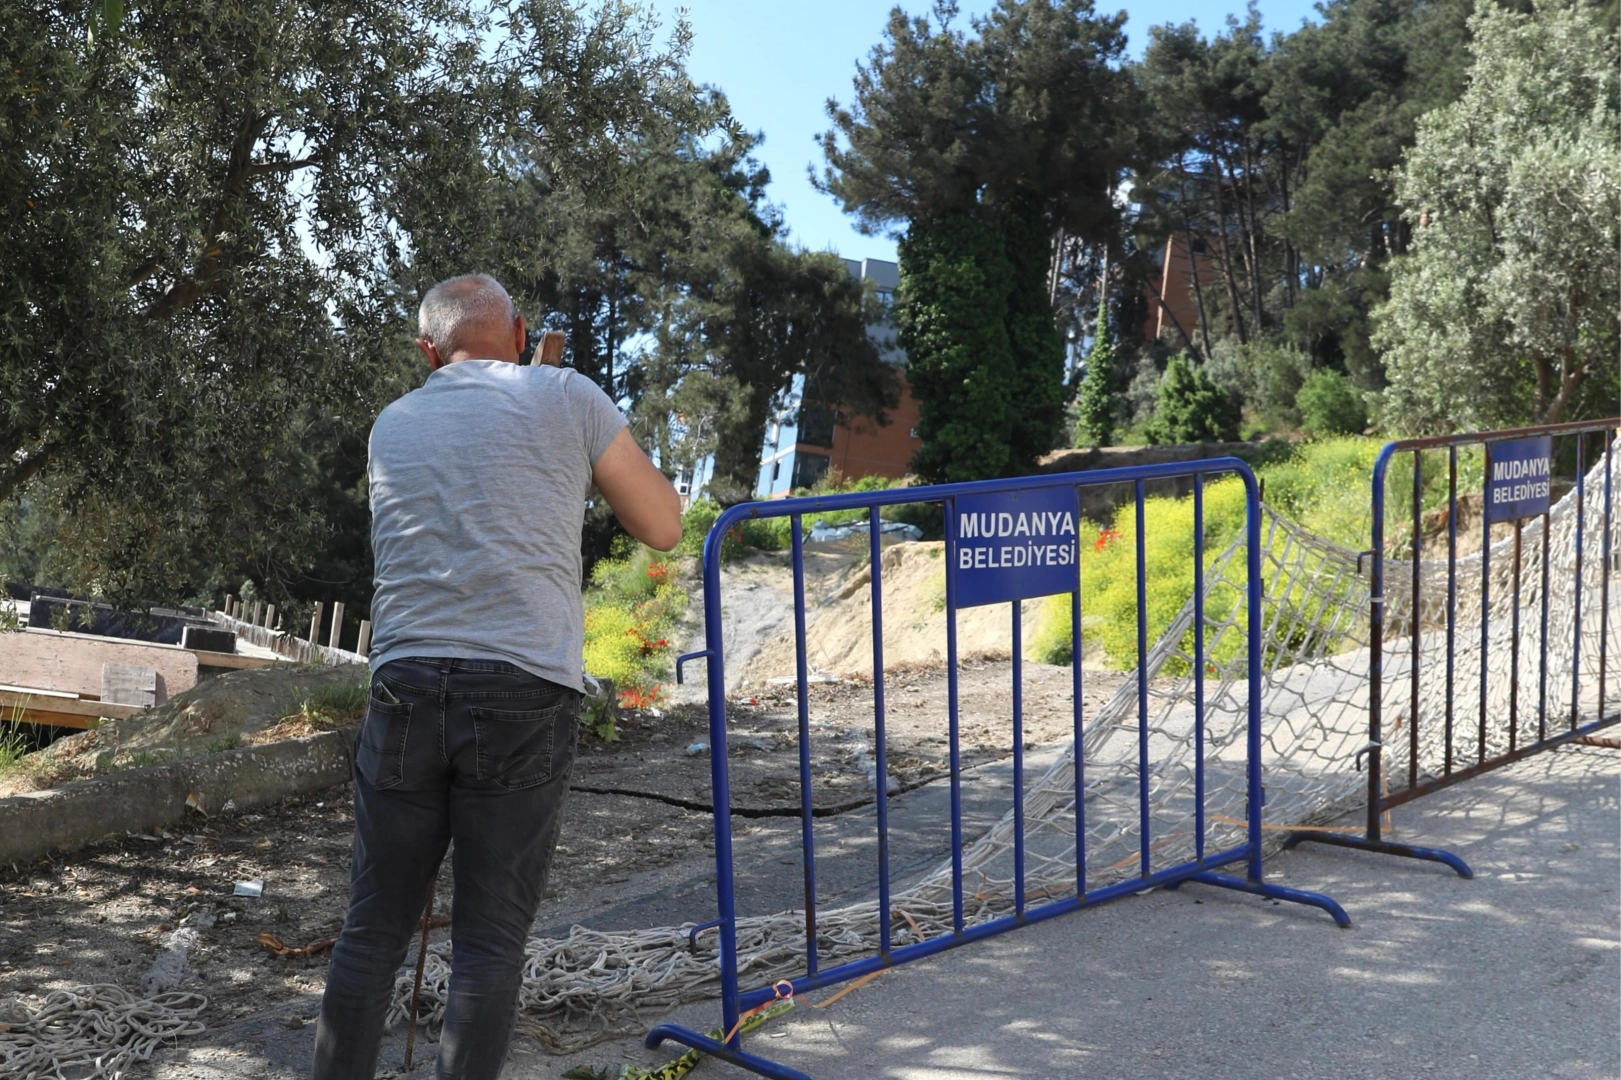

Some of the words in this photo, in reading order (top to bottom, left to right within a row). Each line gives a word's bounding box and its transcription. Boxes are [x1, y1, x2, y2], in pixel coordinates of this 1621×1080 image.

[1493, 457, 1550, 481] MUDANYA
[1493, 478, 1550, 504] BELEDİYESİ
[960, 511, 1076, 538] MUDANYA
[959, 539, 1075, 569] BELEDİYESİ
